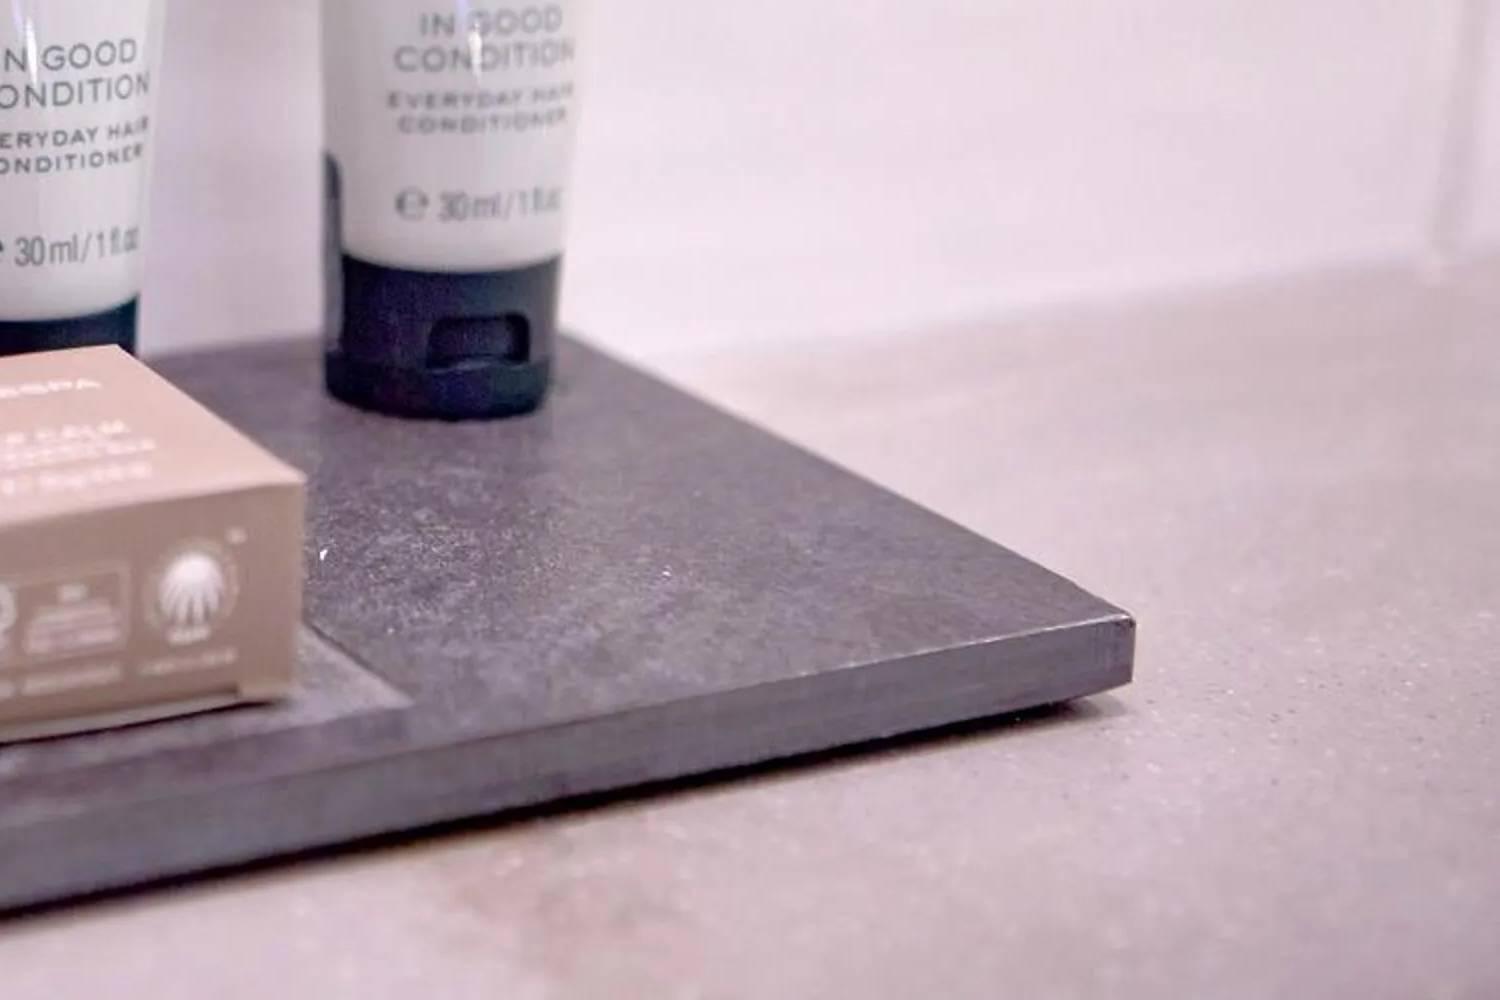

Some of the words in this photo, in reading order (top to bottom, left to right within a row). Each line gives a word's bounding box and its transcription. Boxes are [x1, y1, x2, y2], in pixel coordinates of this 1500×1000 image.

[419, 12, 456, 38] IN
[467, 4, 564, 38] GOOD
[41, 37, 138, 72] GOOD
[393, 37, 576, 73] CONDITION
